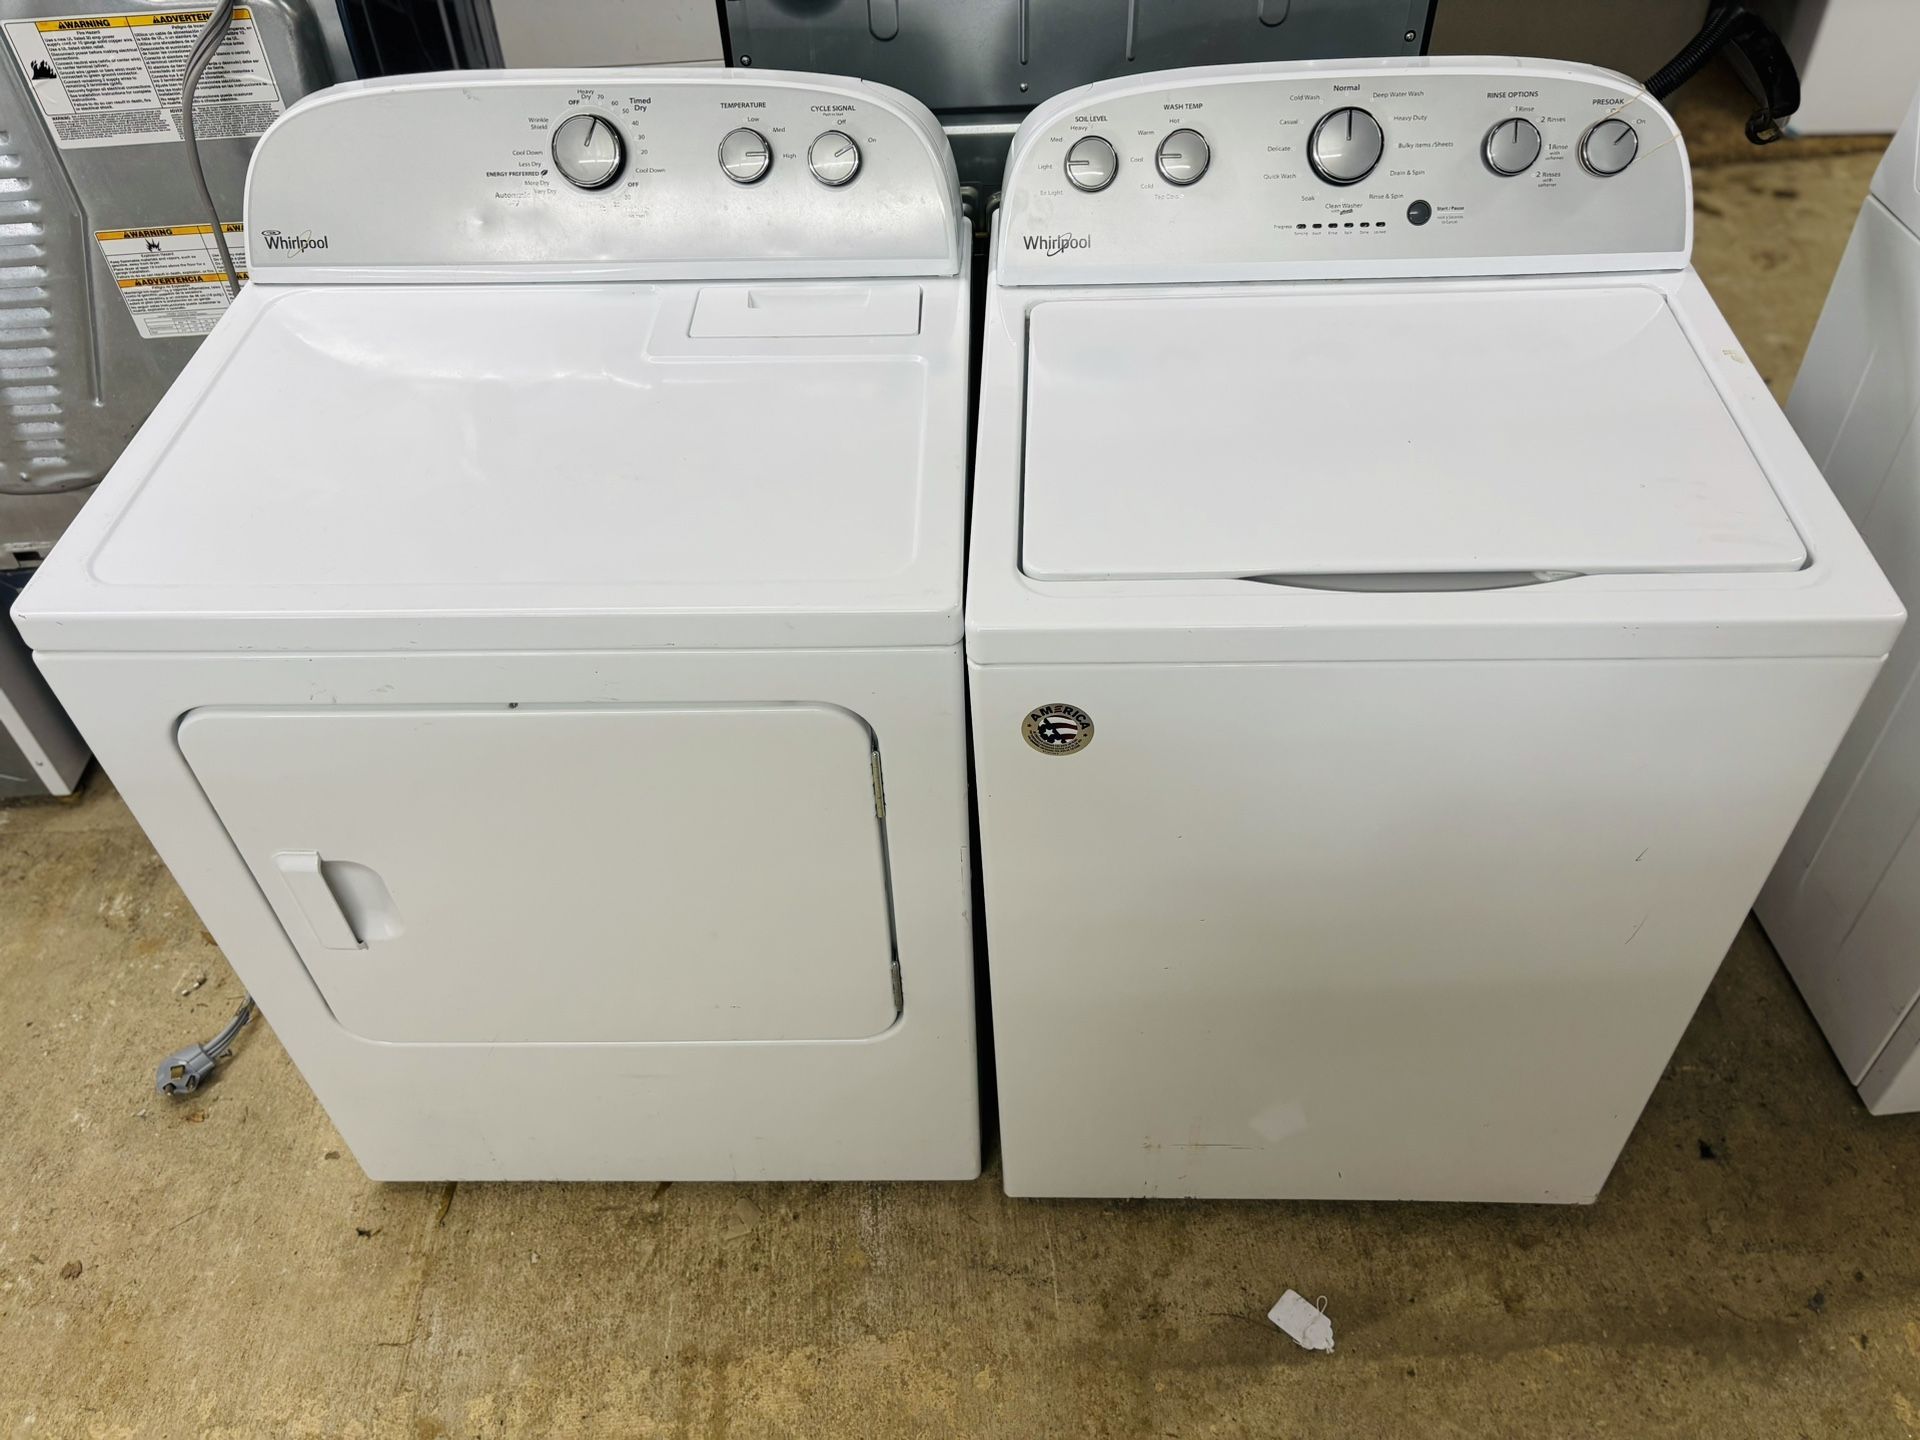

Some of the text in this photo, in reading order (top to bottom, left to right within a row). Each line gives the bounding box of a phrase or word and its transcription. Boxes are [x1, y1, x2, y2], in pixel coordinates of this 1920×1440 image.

[64, 19, 111, 29] WARNING
[130, 228, 173, 238] WARNING
[264, 234, 329, 254] Whirlpool
[1023, 234, 1091, 253] Whirlpool
[142, 276, 203, 286] ADVERTENCIA
[1030, 705, 1090, 730] AMERICA
